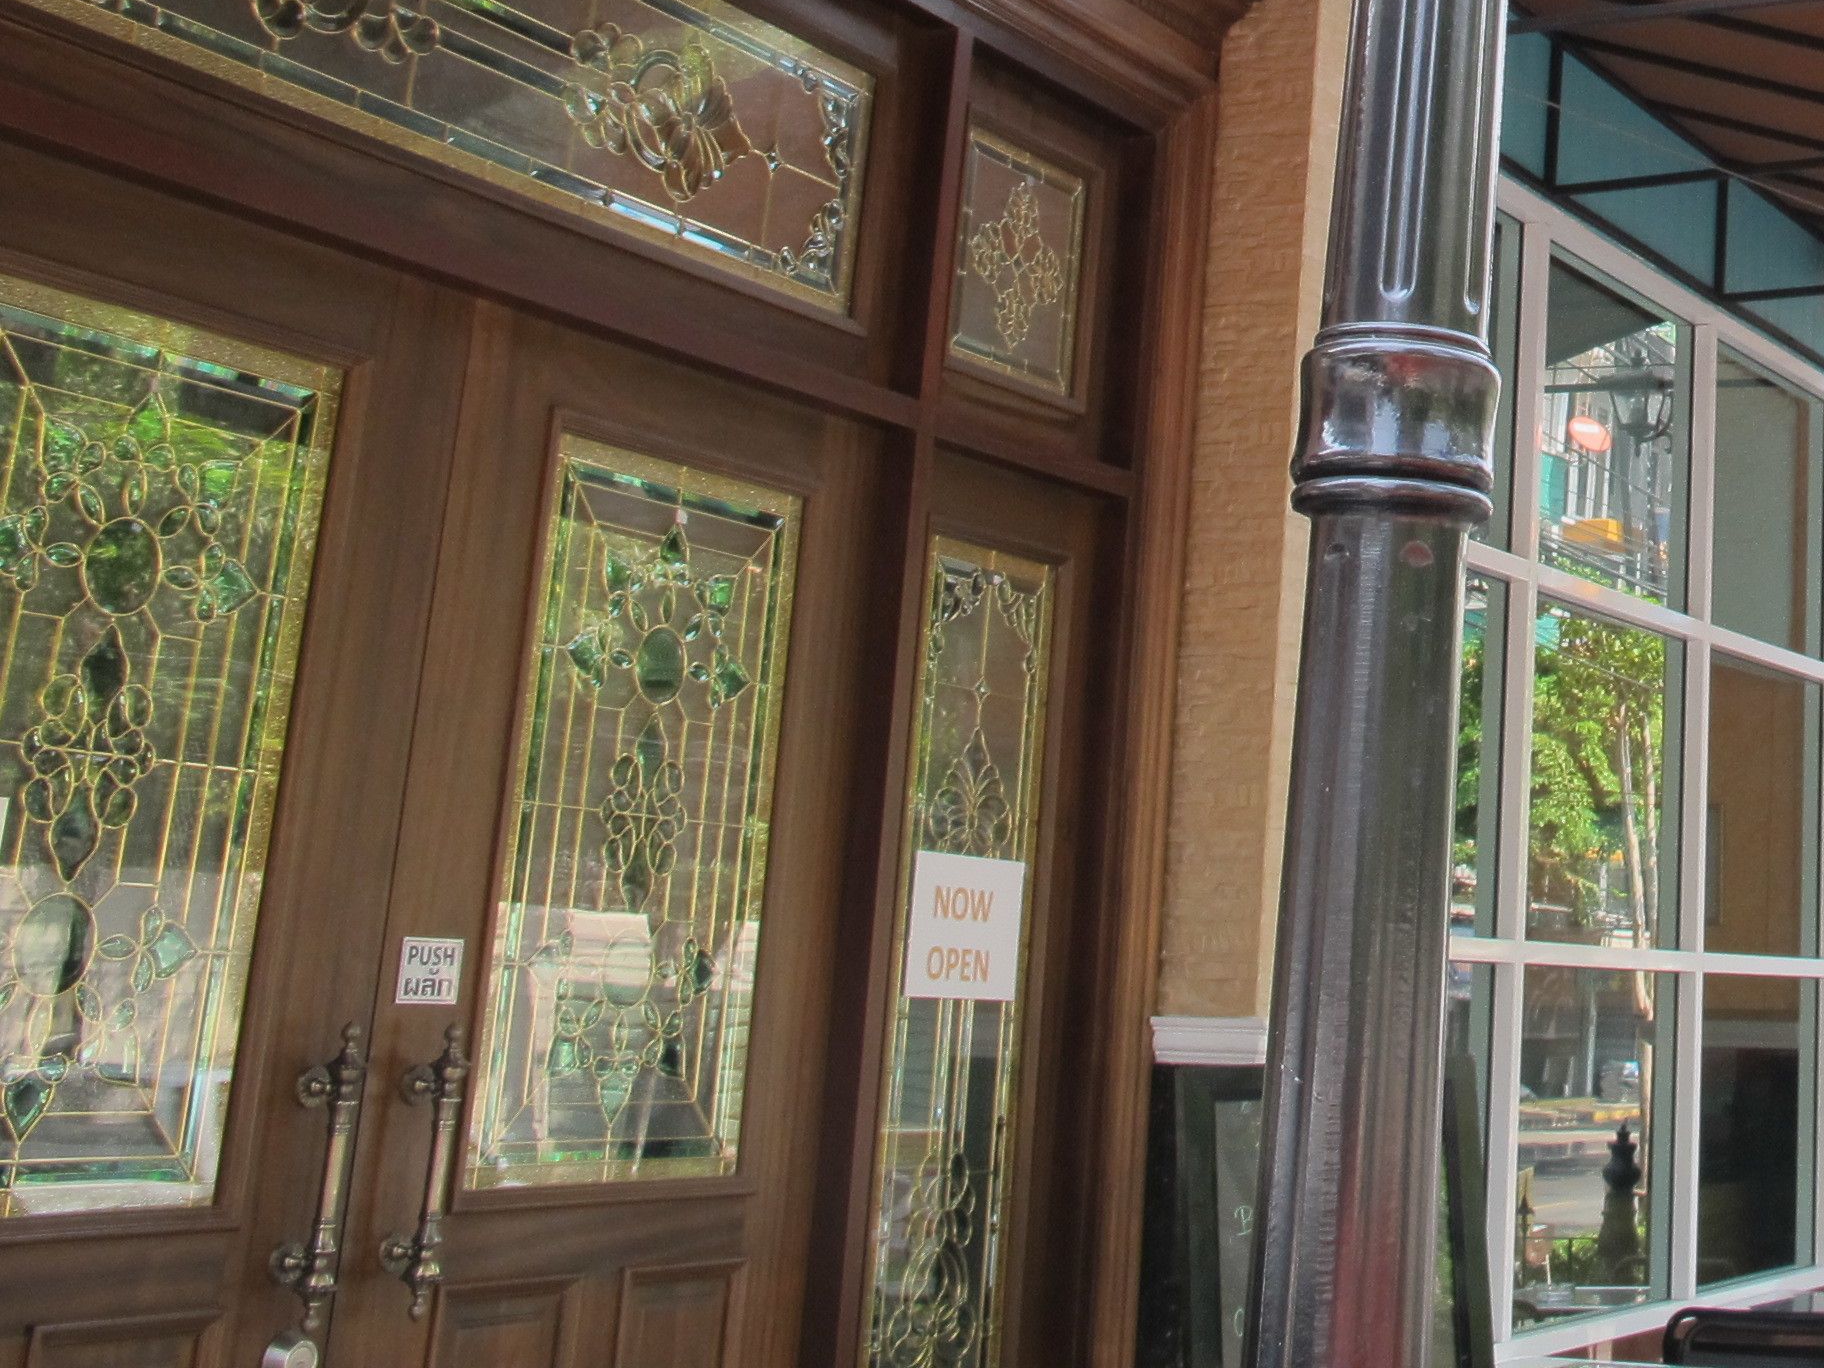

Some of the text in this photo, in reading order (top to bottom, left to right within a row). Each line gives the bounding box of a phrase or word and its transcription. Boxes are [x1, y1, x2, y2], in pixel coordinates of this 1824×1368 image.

[933, 885, 994, 922] NOW
[407, 945, 455, 966] PUSH
[926, 945, 990, 982] OPEN
[403, 967, 453, 996] ผลัก
